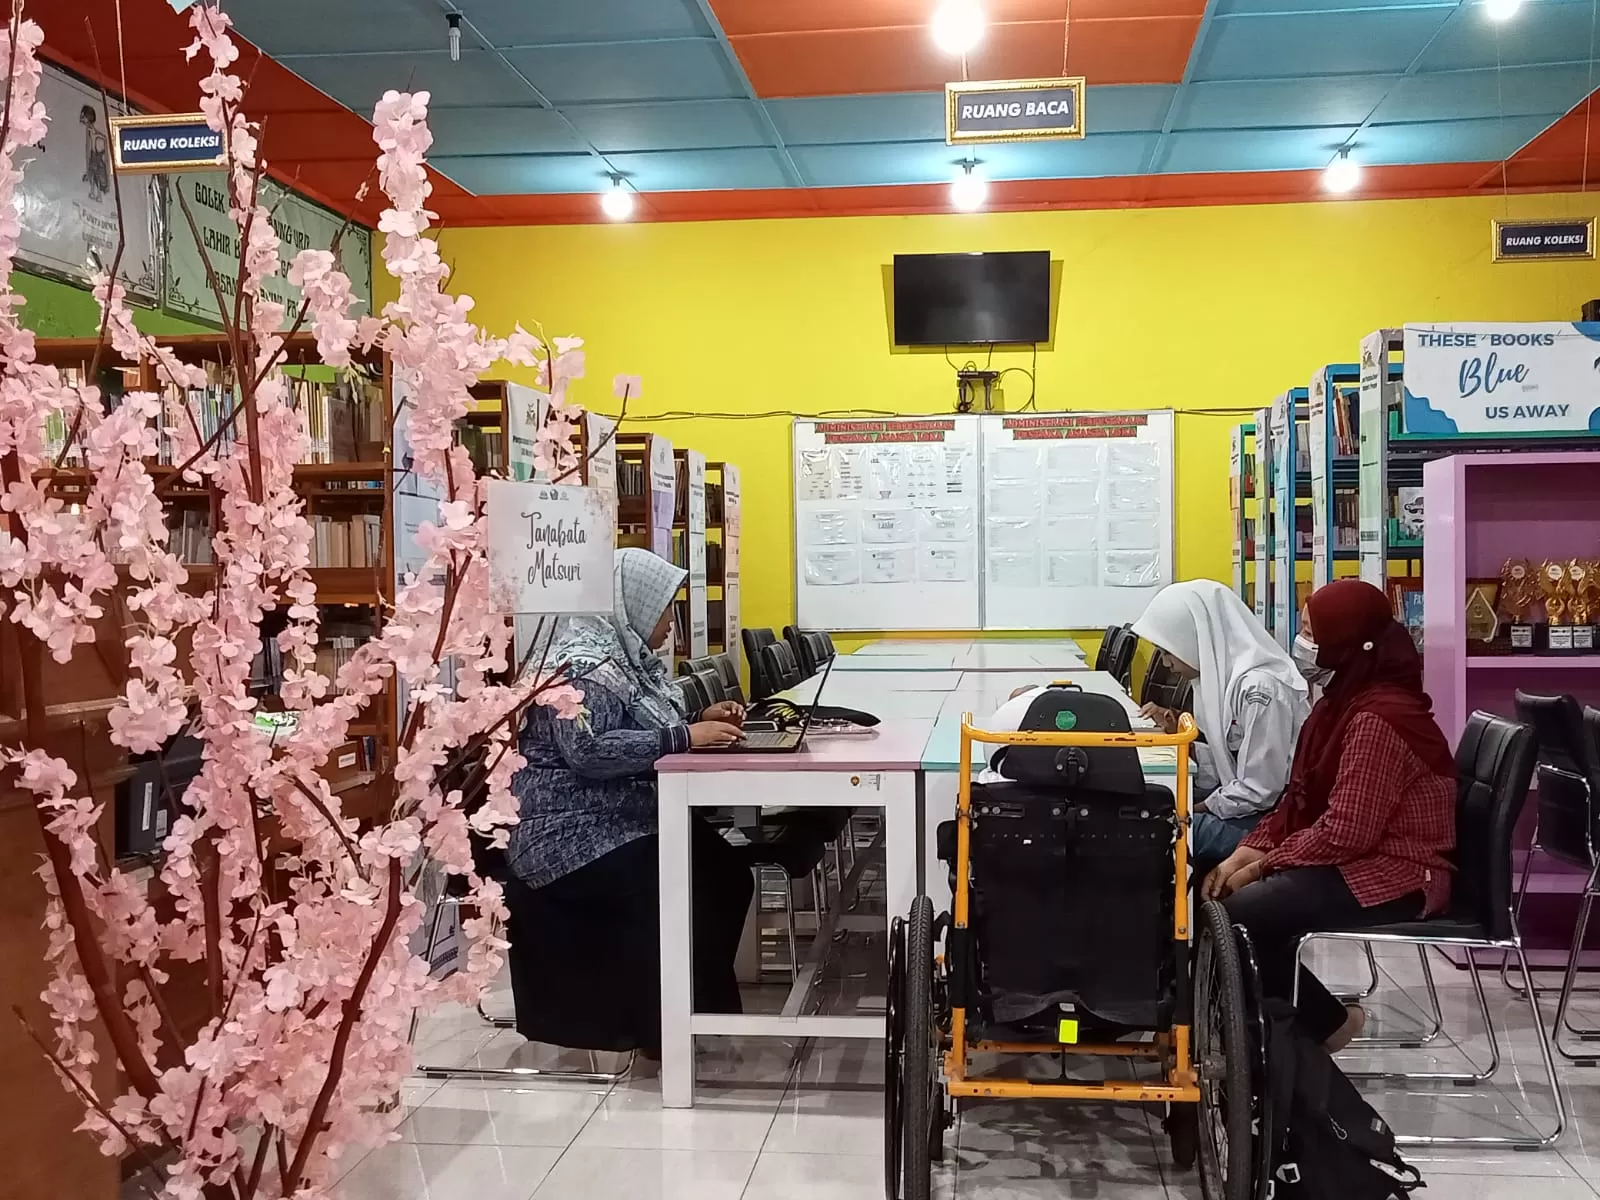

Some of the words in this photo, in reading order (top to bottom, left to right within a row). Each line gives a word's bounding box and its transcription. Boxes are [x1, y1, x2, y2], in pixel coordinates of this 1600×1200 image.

[962, 102, 1022, 119] RUANG
[1025, 100, 1069, 116] BACA
[123, 138, 167, 151] RUANG
[169, 135, 220, 149] KOLEKSI
[194, 181, 226, 214] GOLEK
[203, 226, 231, 257] LAHIR
[1506, 236, 1541, 246] RUANG
[1543, 234, 1584, 245] KOLEKSI
[1418, 333, 1476, 347] THESE
[1490, 333, 1554, 346] BOOKS
[1458, 351, 1530, 399] Blue
[1485, 406, 1509, 419] US
[1512, 404, 1570, 419] AWAY
[520, 511, 587, 550] Tanabata
[527, 548, 582, 589] Matsuri
